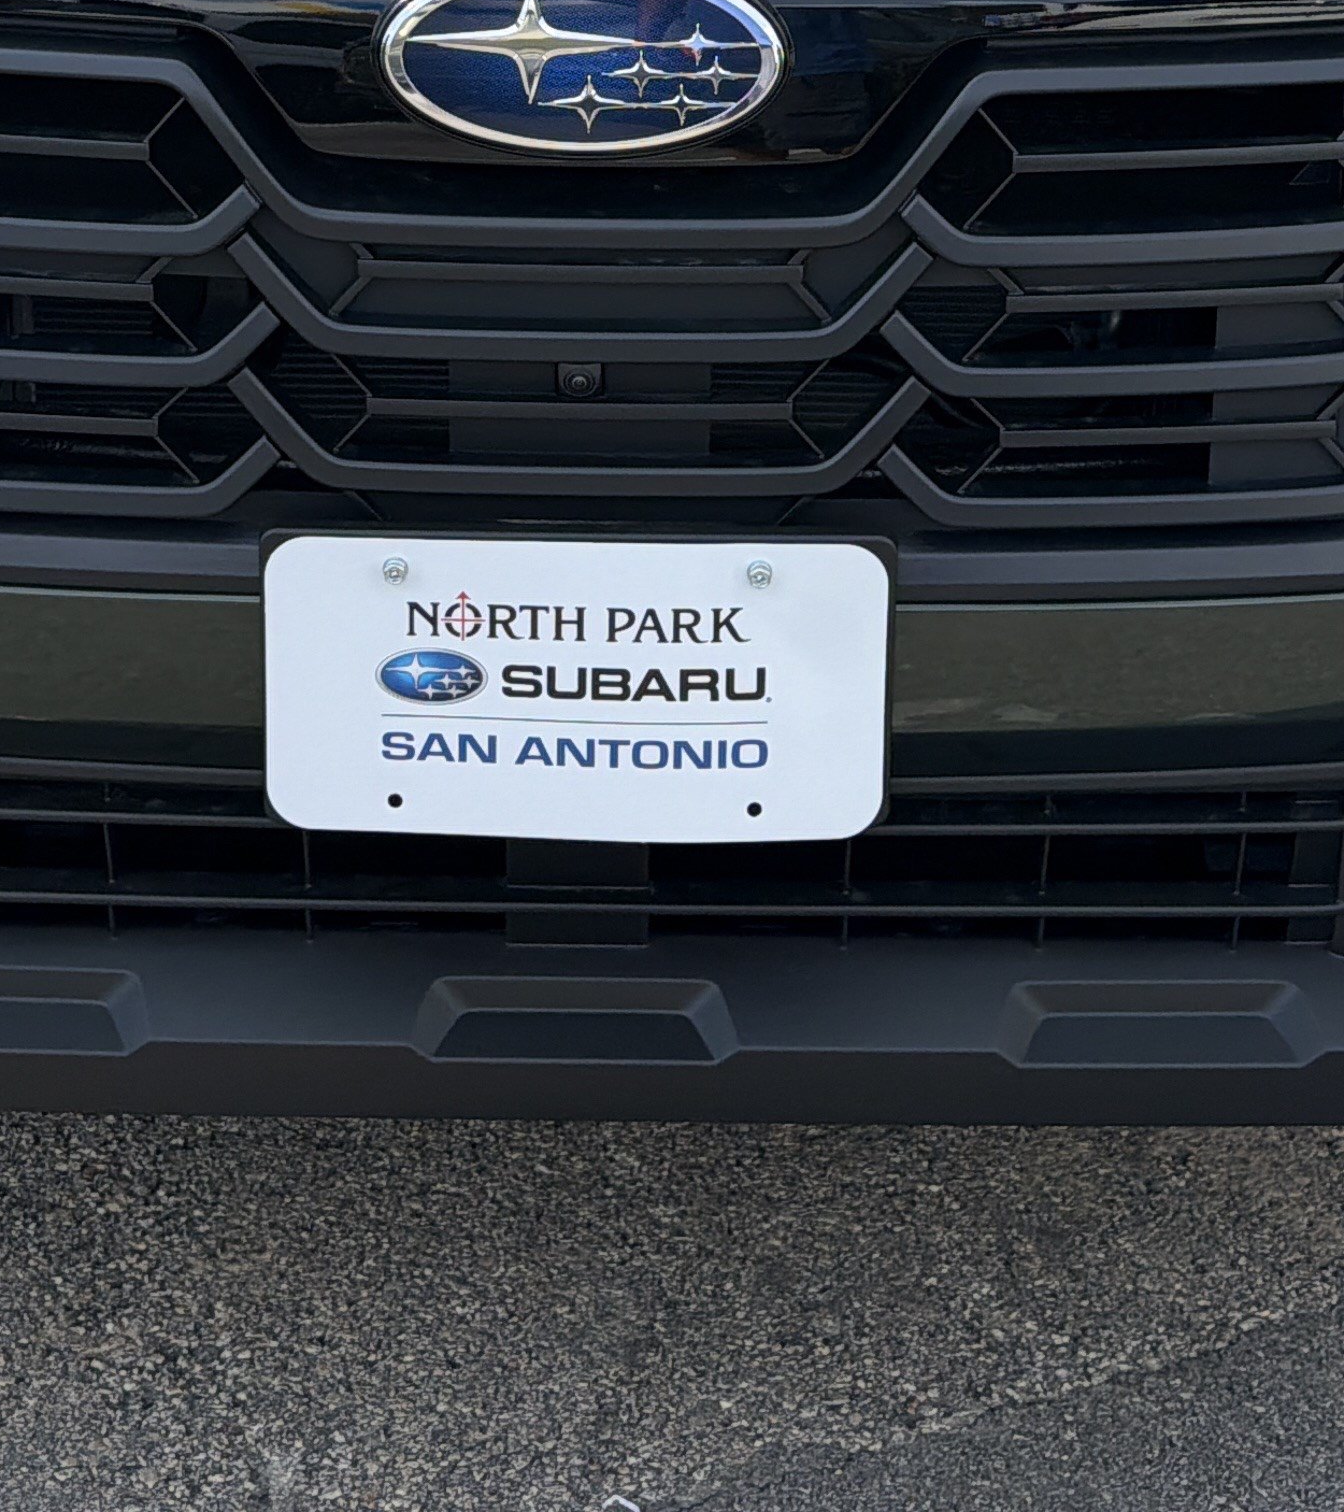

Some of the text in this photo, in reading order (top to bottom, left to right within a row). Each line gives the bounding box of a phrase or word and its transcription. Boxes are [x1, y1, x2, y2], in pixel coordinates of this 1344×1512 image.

[406, 600, 751, 644] NORTH PARK
[502, 665, 766, 702] SUBARU
[382, 732, 769, 770] SAN ANTONIO
